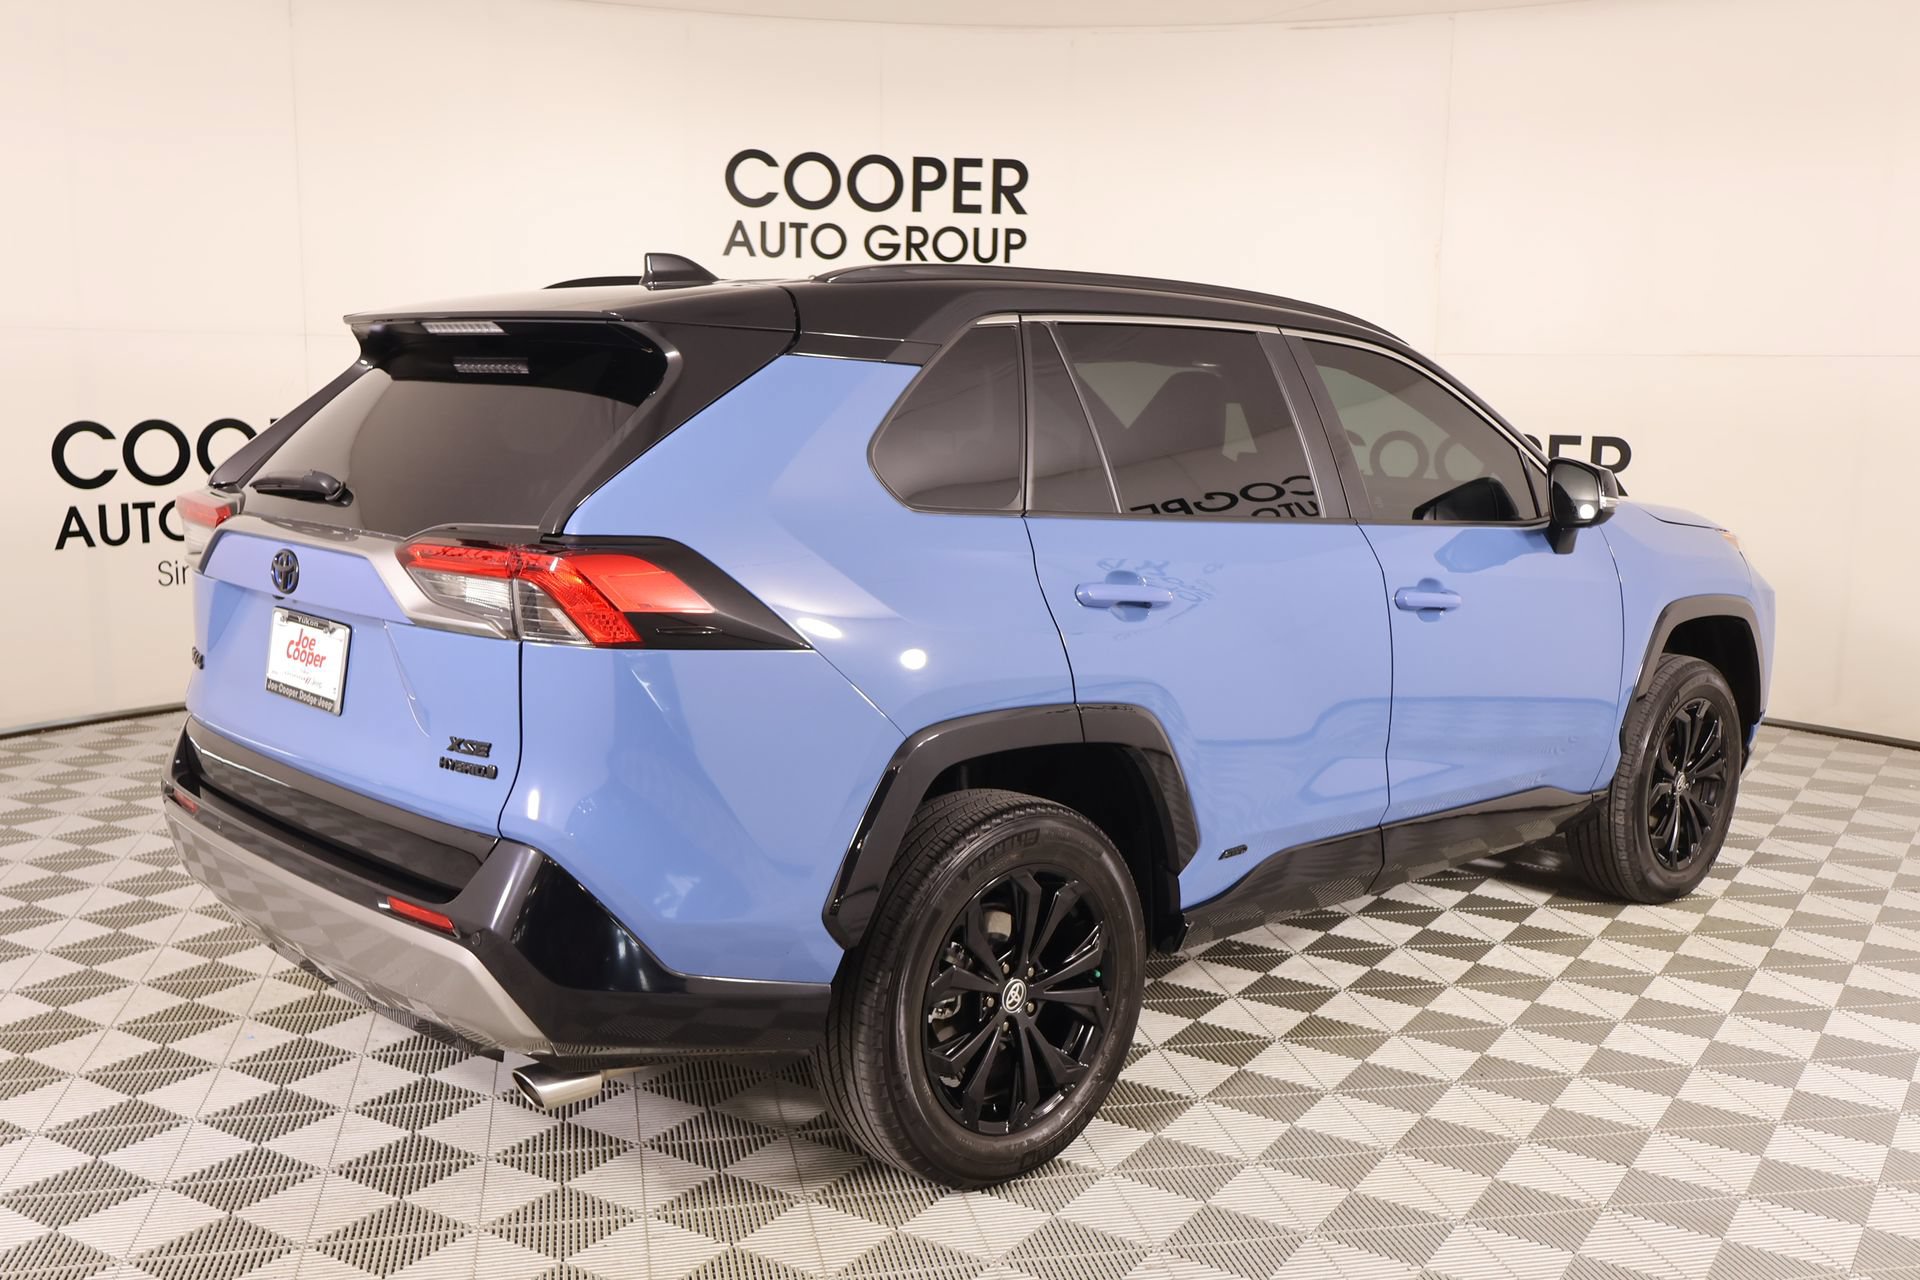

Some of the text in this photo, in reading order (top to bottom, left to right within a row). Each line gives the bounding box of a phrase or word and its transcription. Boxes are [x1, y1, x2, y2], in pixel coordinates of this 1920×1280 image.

[725, 149, 1029, 215] COOPER
[722, 220, 1027, 263] AUTO GROUP
[51, 418, 278, 490] COO
[286, 639, 326, 668] Cooper
[295, 628, 316, 651] Joe
[267, 680, 278, 690] Joe
[279, 683, 298, 697] Cooper
[299, 690, 317, 705] Dodge
[318, 697, 334, 711] Jeep
[446, 736, 492, 758] XSE
